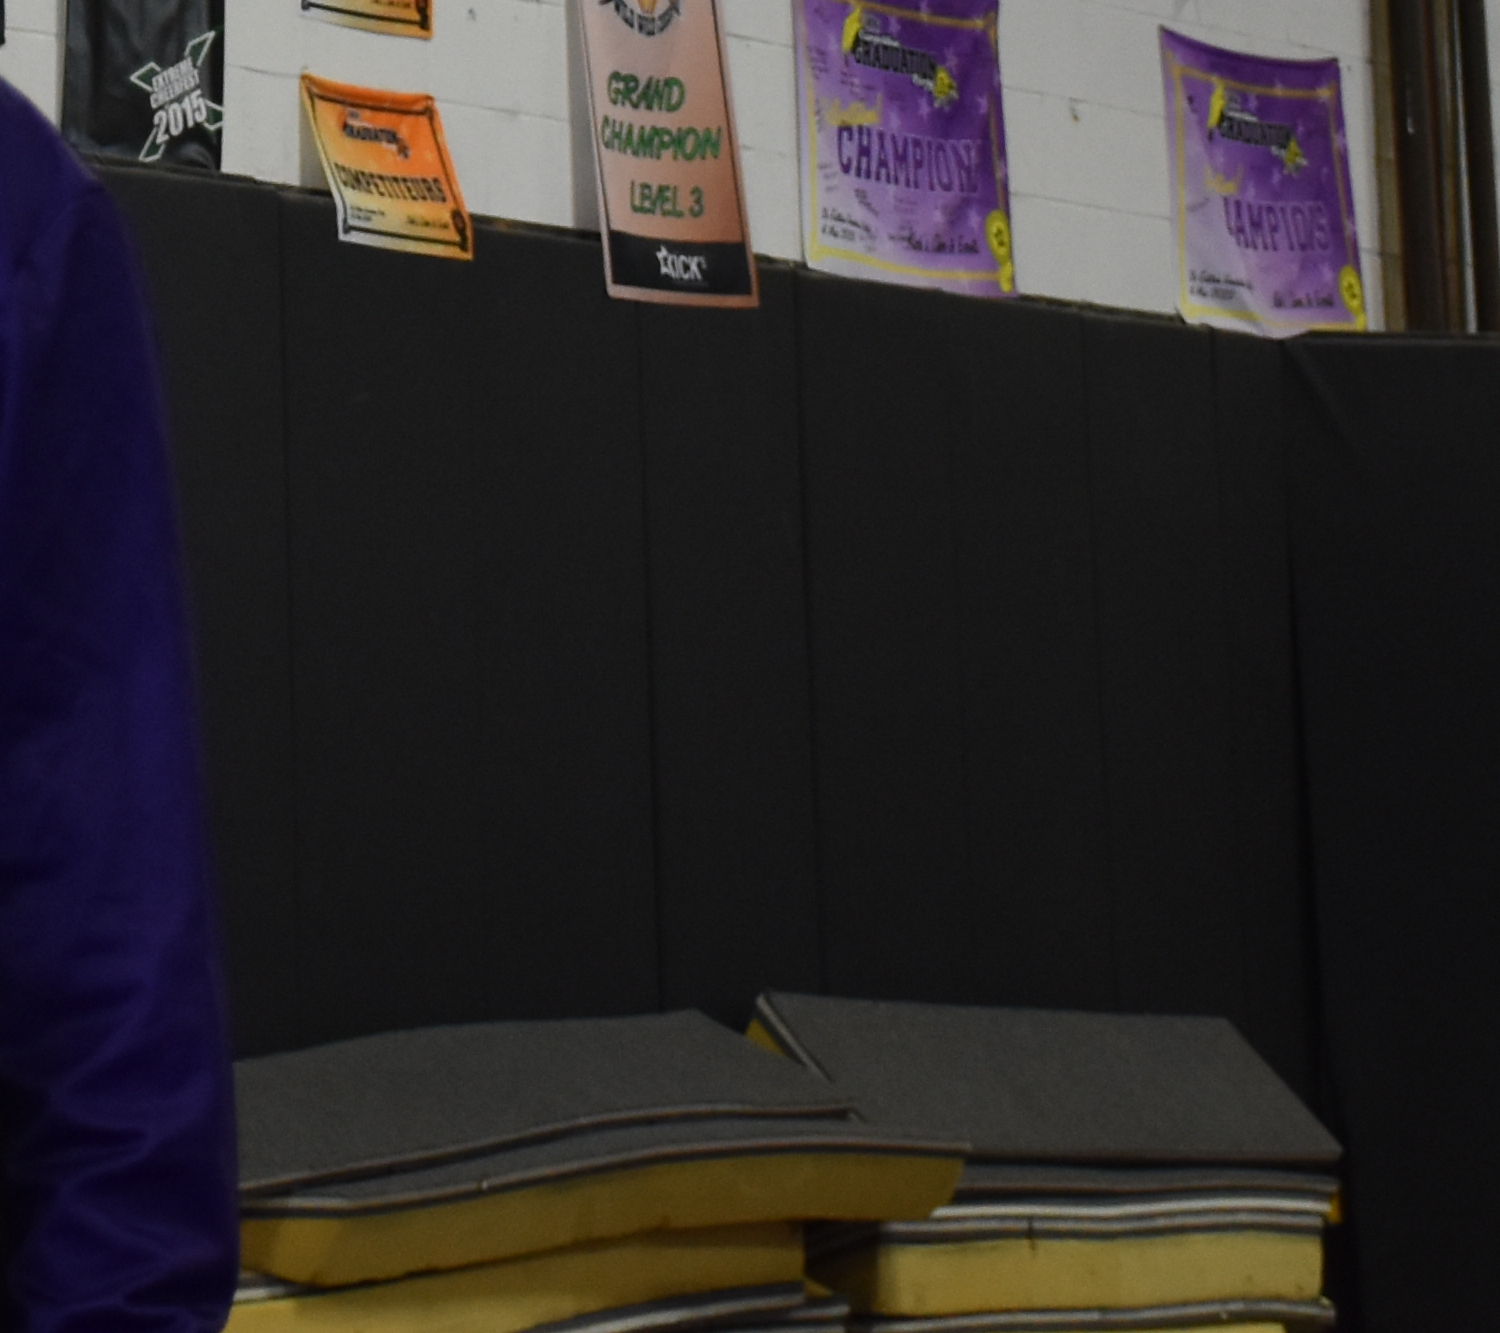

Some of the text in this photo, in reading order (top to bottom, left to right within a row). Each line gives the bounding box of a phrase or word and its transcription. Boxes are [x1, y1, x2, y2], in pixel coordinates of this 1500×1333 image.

[608, 70, 685, 113] GRAND
[153, 91, 208, 145] 2015
[601, 115, 721, 161] CHAMPION
[335, 161, 448, 206] COMPETITEURS
[631, 181, 683, 215] LEVEL
